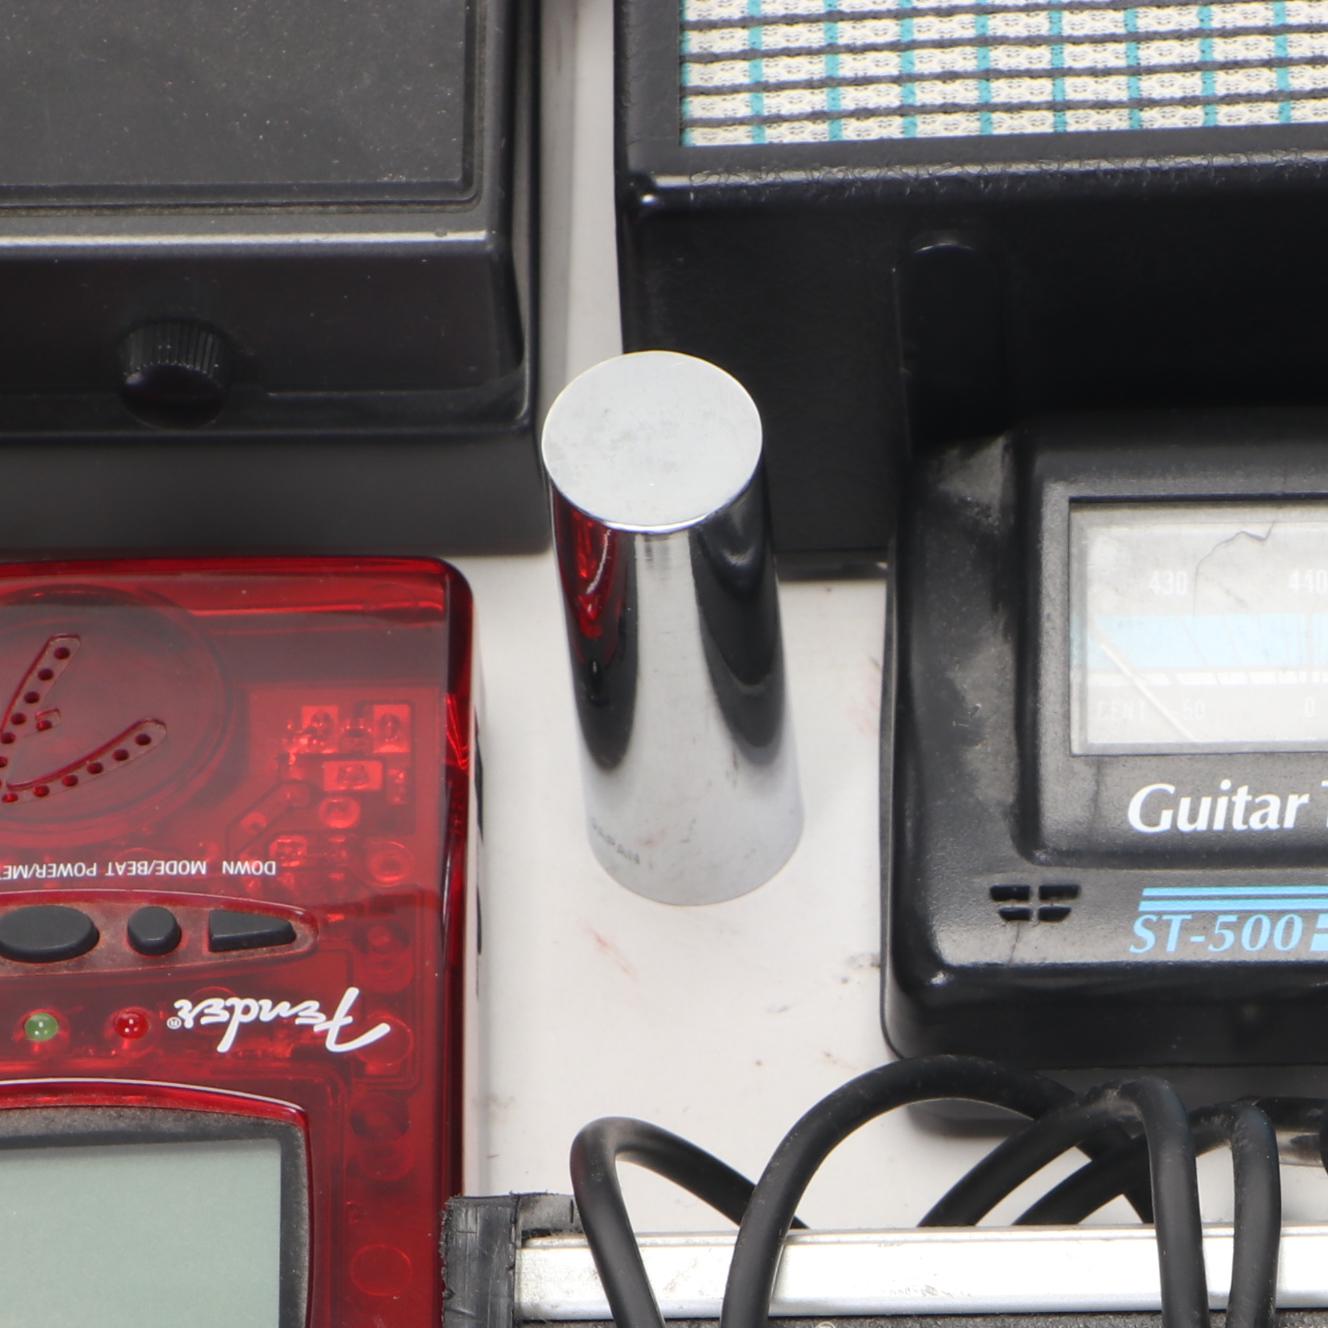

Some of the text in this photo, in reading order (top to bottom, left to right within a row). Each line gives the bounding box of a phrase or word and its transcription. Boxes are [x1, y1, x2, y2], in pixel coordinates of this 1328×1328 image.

[1148, 569, 1188, 597] 430
[1288, 568, 1328, 595] 440
[1127, 778, 1310, 833] Guitar
[105, 860, 207, 877] MODE/BEAT
[222, 860, 276, 876] DOWN
[1129, 913, 1304, 953] ST-500
